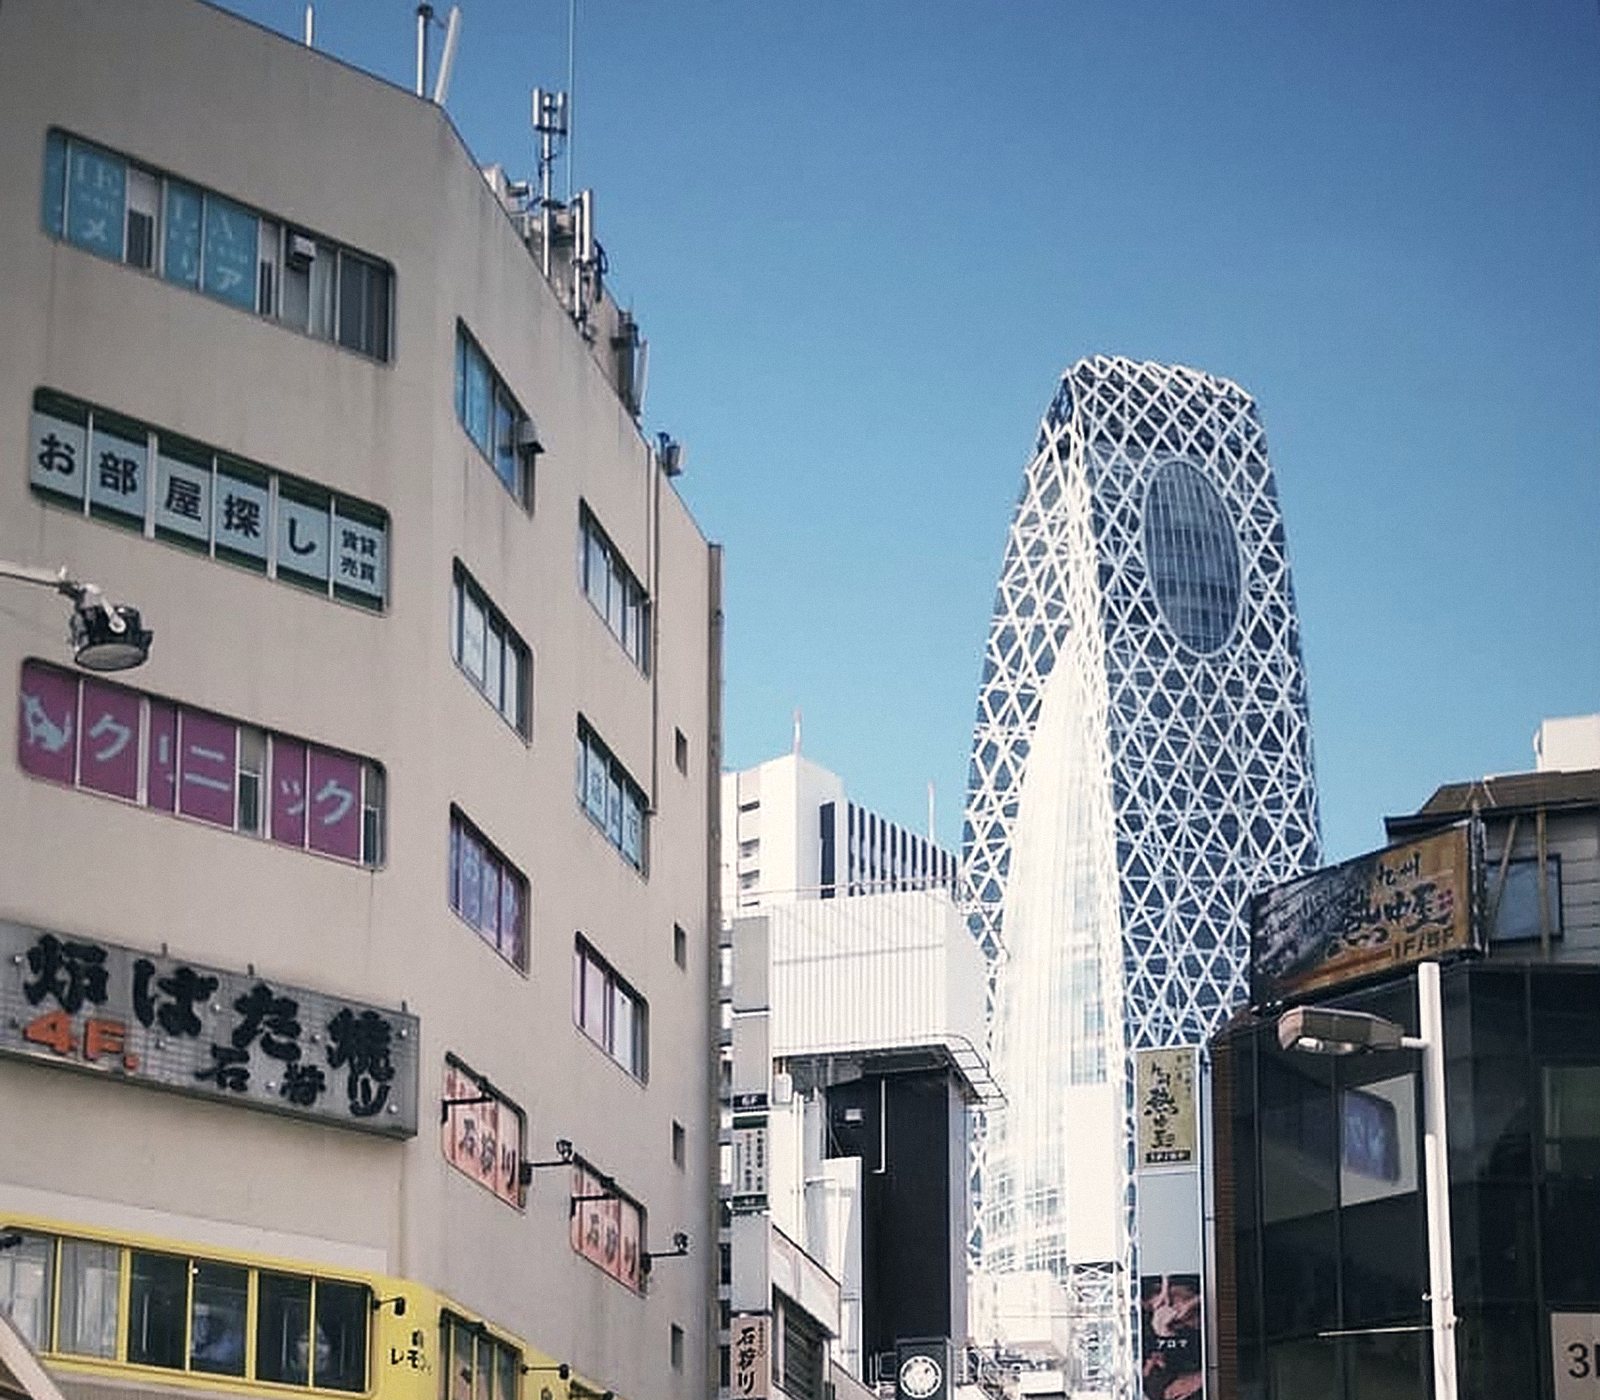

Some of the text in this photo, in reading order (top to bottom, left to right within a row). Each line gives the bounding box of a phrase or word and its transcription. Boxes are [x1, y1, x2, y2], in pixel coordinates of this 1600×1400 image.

[38, 434, 316, 556] お部屋探し
